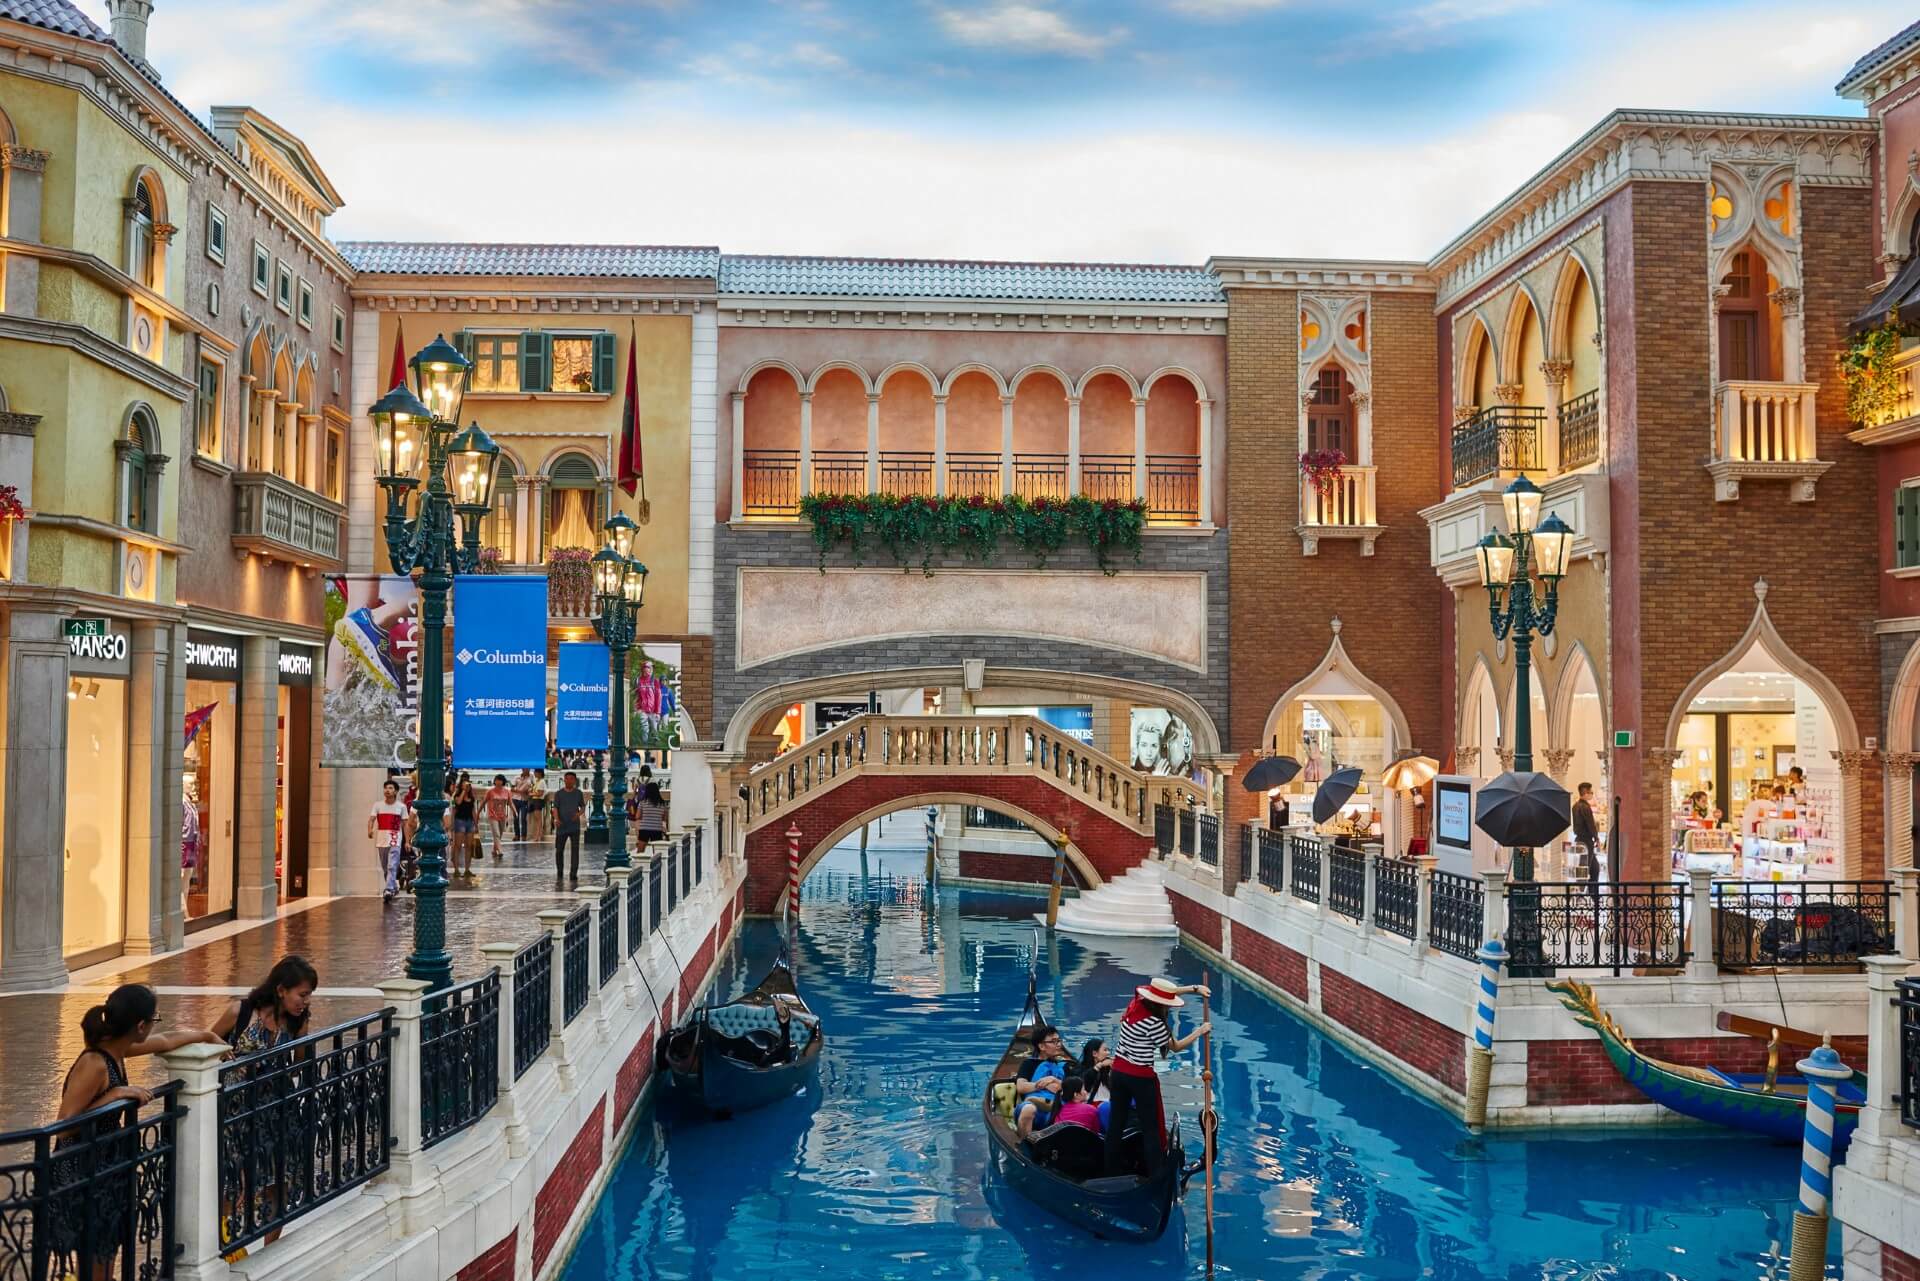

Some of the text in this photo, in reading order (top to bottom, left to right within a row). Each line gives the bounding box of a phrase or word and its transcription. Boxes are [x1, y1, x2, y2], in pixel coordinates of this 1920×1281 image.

[70, 634, 126, 660] MANGO
[473, 649, 544, 664] Columbia
[569, 683, 608, 692] Columbia
